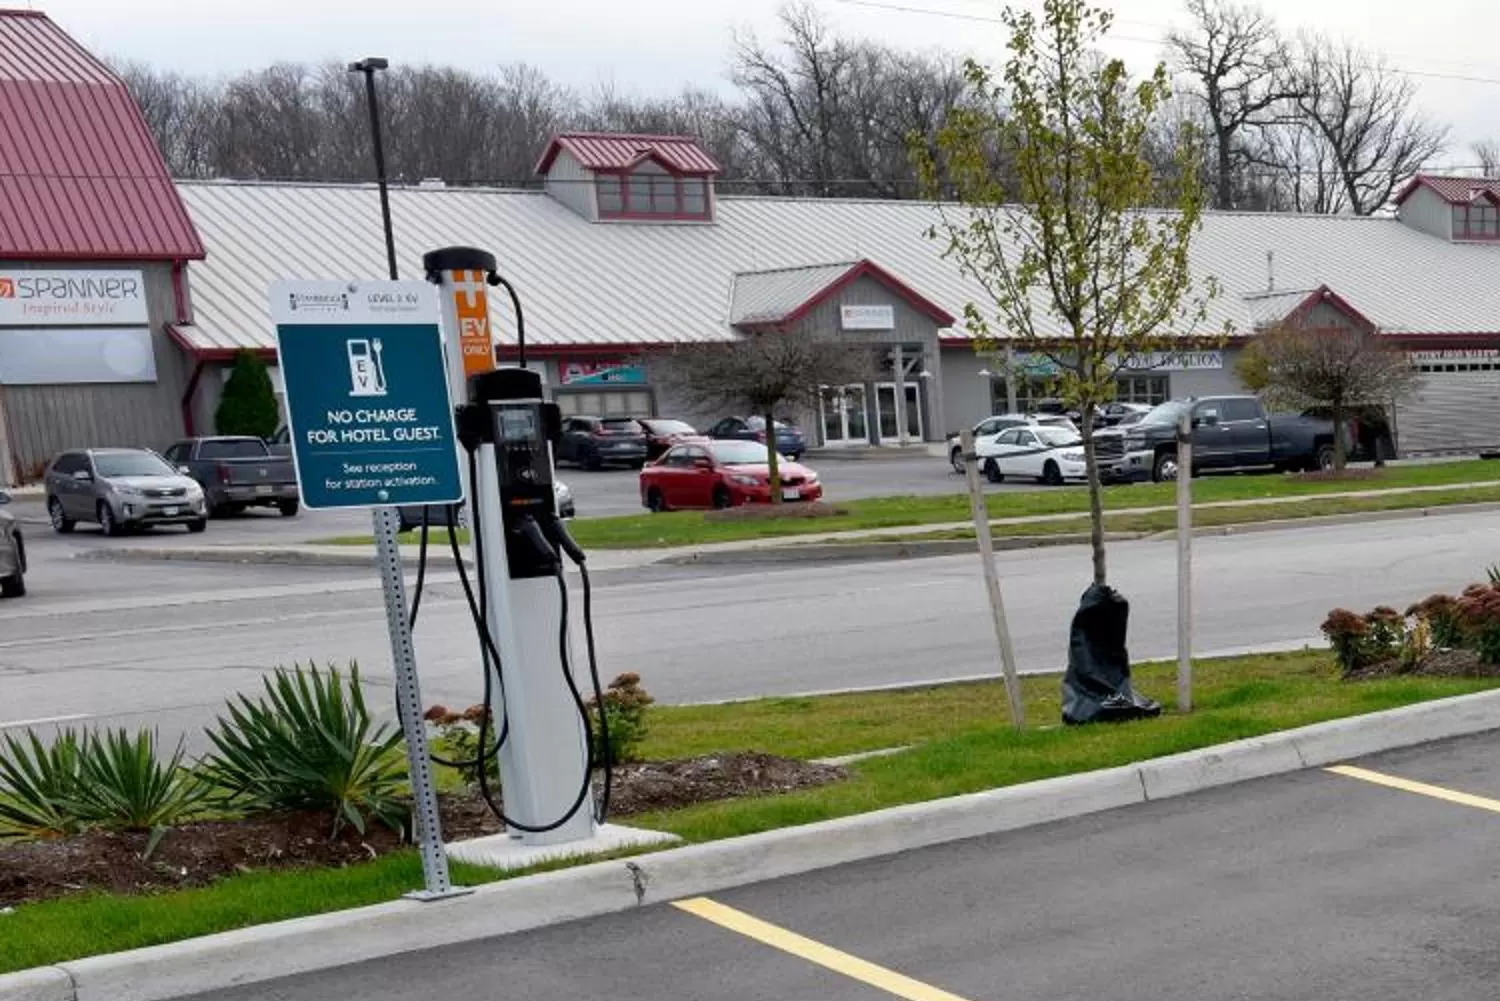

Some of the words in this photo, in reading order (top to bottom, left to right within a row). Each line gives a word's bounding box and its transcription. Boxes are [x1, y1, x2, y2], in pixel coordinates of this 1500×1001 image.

[461, 318, 487, 336] EV
[464, 343, 490, 354] ONLY
[327, 411, 353, 424] NO
[355, 408, 418, 423] CHARGE
[307, 430, 339, 445] FOR
[341, 428, 391, 444] HOTEL
[342, 463, 363, 474] See
[365, 461, 417, 474] reception
[325, 478, 342, 489] for
[345, 476, 383, 488] station
